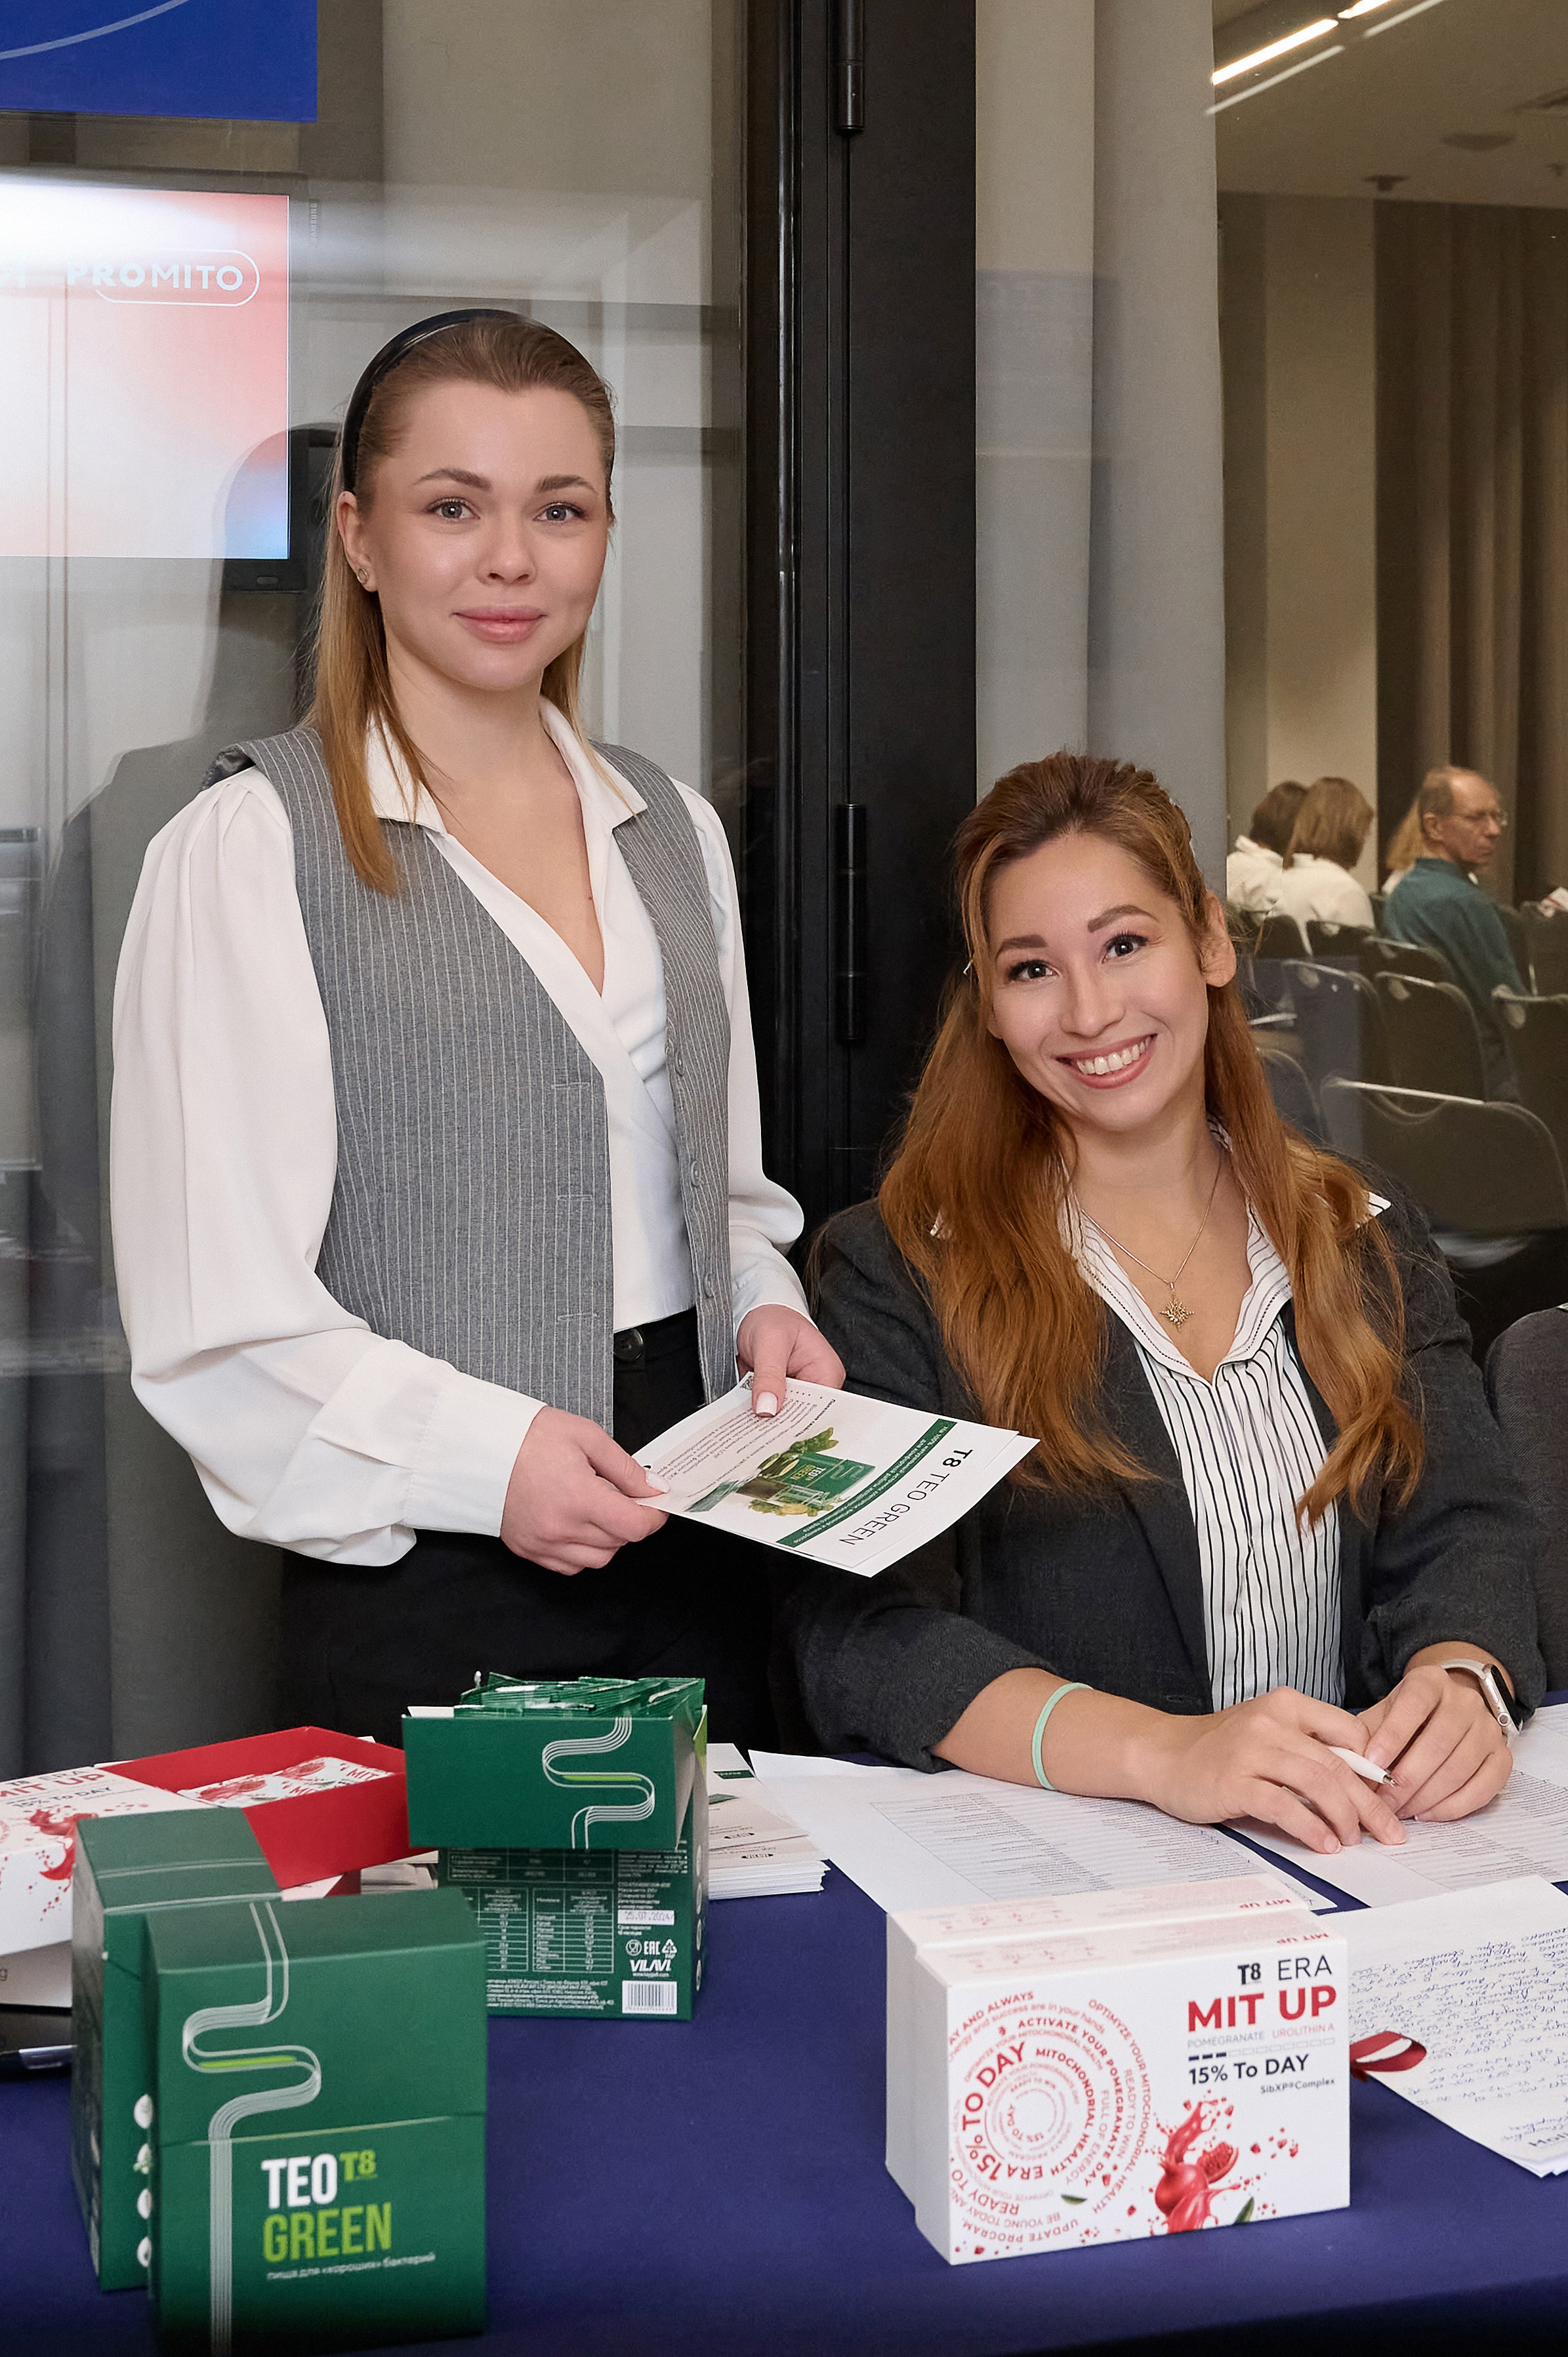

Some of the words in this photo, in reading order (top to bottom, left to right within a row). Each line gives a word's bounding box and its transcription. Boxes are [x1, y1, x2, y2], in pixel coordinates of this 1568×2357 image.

[66, 263, 243, 291] PROMITO
[788, 1463, 817, 1480] GREEN
[806, 1466, 827, 1477] TEO
[942, 1449, 973, 1467] T8
[907, 1473, 950, 1501] TEO
[838, 1503, 910, 1545] GREEN
[53, 1773, 105, 1785] UP
[629, 1959, 672, 1972] VILAVI
[1237, 1963, 1262, 1985] T8
[1278, 1955, 1332, 1980] ERA
[962, 2010, 984, 2031] AND
[987, 1991, 1034, 2013] ALWAYS
[1088, 1999, 1132, 2041] OPTIMYZE
[1188, 1992, 1265, 2032] MIT
[1279, 1985, 1337, 2021] UP
[1018, 2017, 1079, 2034] ACTIVATE
[1187, 2031, 1265, 2048] POMEGRANATE
[1272, 2024, 1326, 2039] UROLITHIN
[1327, 2023, 1335, 2032] A
[1081, 2030, 1108, 2058] YOUR
[1130, 2039, 1147, 2071] YOUR
[976, 2040, 1025, 2088] DAY
[1188, 2064, 1228, 2085] 15%
[1233, 2062, 1258, 2079] To
[1266, 2053, 1309, 2075] DAY
[1035, 2047, 1096, 2129] MITOCHONDRIAL
[962, 2093, 983, 2131] TO
[1103, 2058, 1124, 2159] POMEGRANATE
[1124, 2073, 1151, 2172] MITOCHONDRIAL
[965, 2134, 1002, 2182] 15%
[1050, 2133, 1090, 2176] HEALTH
[261, 2153, 338, 2209] TEO
[339, 2148, 377, 2182] T8
[951, 2169, 969, 2191] TO
[1007, 2163, 1044, 2180] ERA
[1084, 2161, 1104, 2187] DAY
[968, 2188, 1020, 2216] READY
[1092, 2175, 1128, 2214] HEALTH
[263, 2201, 392, 2263] GREEN
[1004, 2217, 1043, 2228] YOUNG
[1029, 2219, 1079, 2243] UPDATE
[382, 2251, 436, 2268] бактерий
